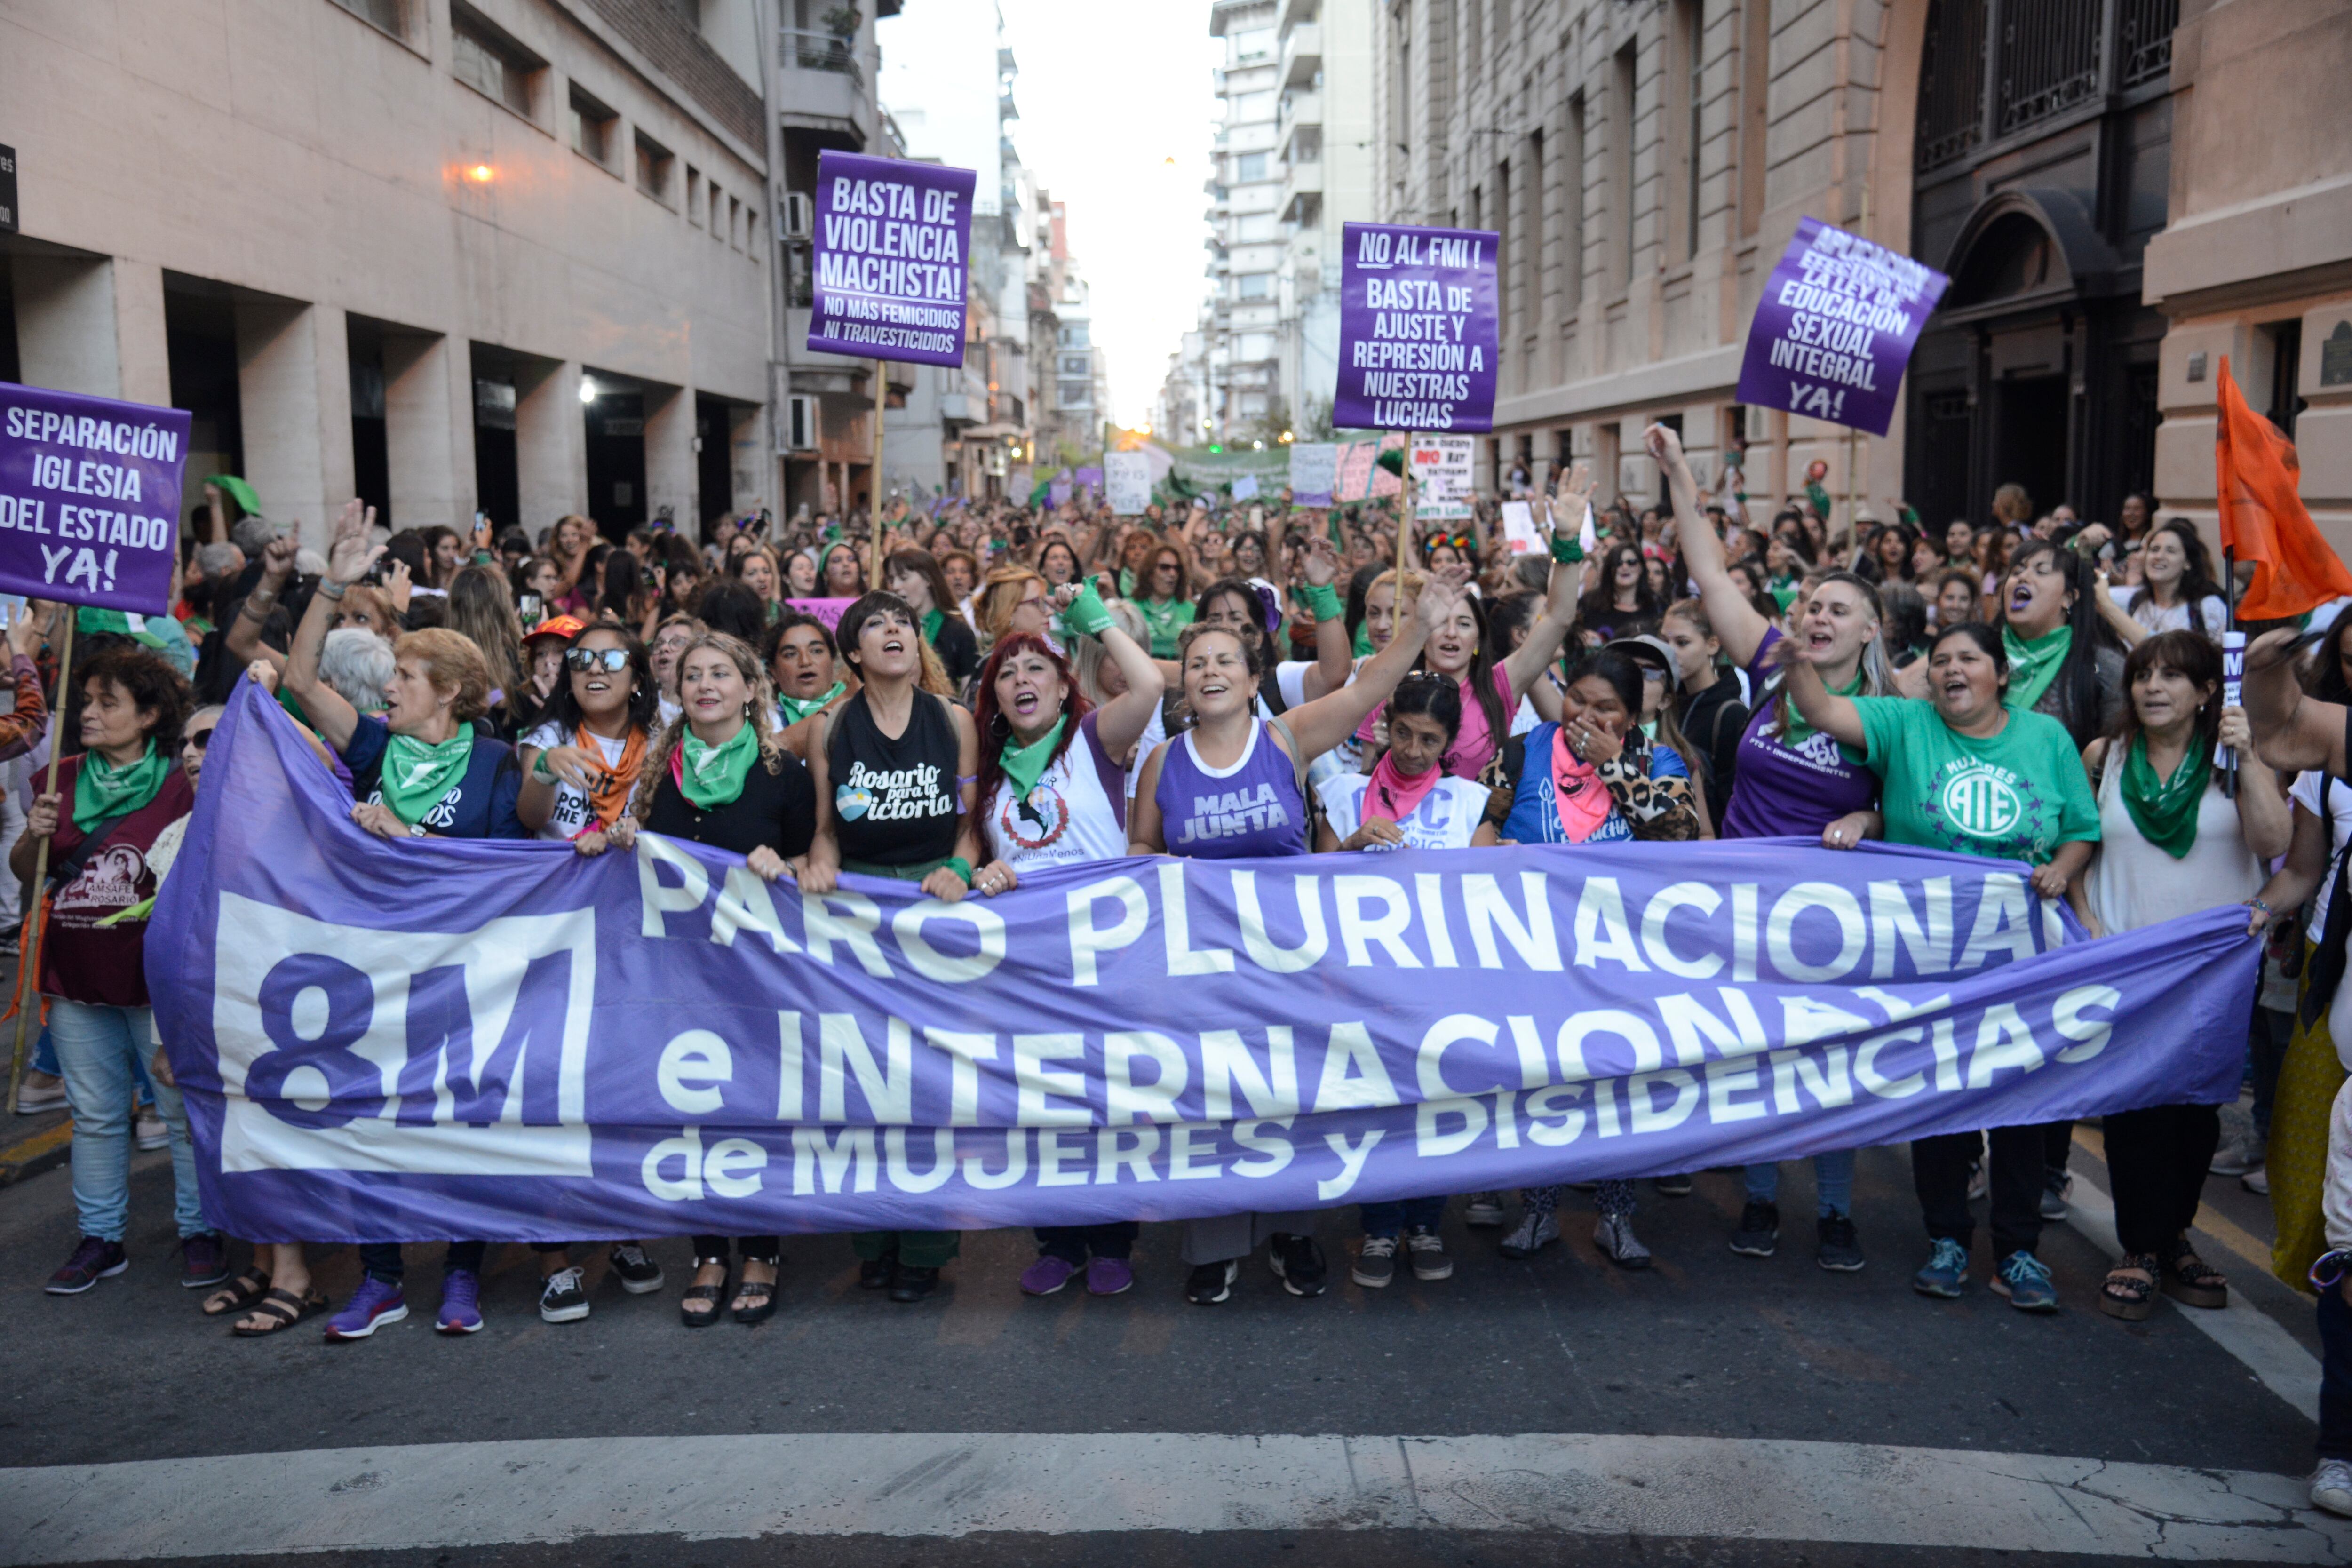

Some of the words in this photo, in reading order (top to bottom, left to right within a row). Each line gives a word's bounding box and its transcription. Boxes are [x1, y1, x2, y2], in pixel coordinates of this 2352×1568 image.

[832, 176, 917, 221] BASTA
[923, 188, 959, 226] DE
[824, 214, 960, 264] VIOLENCIA
[1359, 232, 1391, 264] NO
[1394, 235, 1423, 265] AL
[1429, 237, 1469, 269] FMI
[820, 252, 961, 301] MACHISTA!
[824, 296, 844, 317] NO
[847, 298, 879, 321] MÁS
[882, 303, 960, 330] FEMICIDIOS
[1367, 278, 1442, 311] BASTA
[1447, 286, 1473, 313] DE
[824, 320, 840, 340] NI
[843, 322, 956, 354] TRAVESTICIDIOS
[1374, 311, 1446, 342] AJUSTE
[1452, 315, 1466, 342] Y
[1787, 311, 1875, 360] SEXUAL
[1353, 339, 1466, 372] REPRESIÓN
[1469, 345, 1484, 372] A
[1770, 338, 1876, 392] INTEGRAL
[1363, 371, 1470, 401] NUESTRAS
[1790, 381, 1846, 419] YA!
[1374, 400, 1454, 429] LUCHAS
[6, 407, 178, 463] SEPARACIÓN
[1415, 449, 1440, 464] NO
[32, 453, 142, 502] IGLESIA
[0, 494, 51, 534] DEL
[58, 503, 169, 552] ESTADO
[40, 542, 119, 593] YA!
[848, 761, 941, 789] Rosario
[1772, 748, 1850, 779] INDEPENDIENTES
[885, 786, 923, 803] para
[924, 782, 940, 796] la
[1194, 782, 1278, 817] MALA
[1949, 773, 2011, 831] ATE
[552, 805, 580, 824] THE
[1177, 802, 1291, 844] JUNTA
[1012, 848, 1084, 865] #NiUnaMenos
[88, 884, 131, 894] AMSAFE
[90, 895, 136, 904] ROSARIO
[637, 831, 1006, 983] PARO
[244, 948, 572, 1129] 8M
[657, 1029, 733, 1114] e
[642, 1124, 767, 1201] de
[791, 1114, 1296, 1196] MUJERES
[1317, 1129, 1386, 1201] y
[1415, 984, 2123, 1157] DISIDENCIAS
